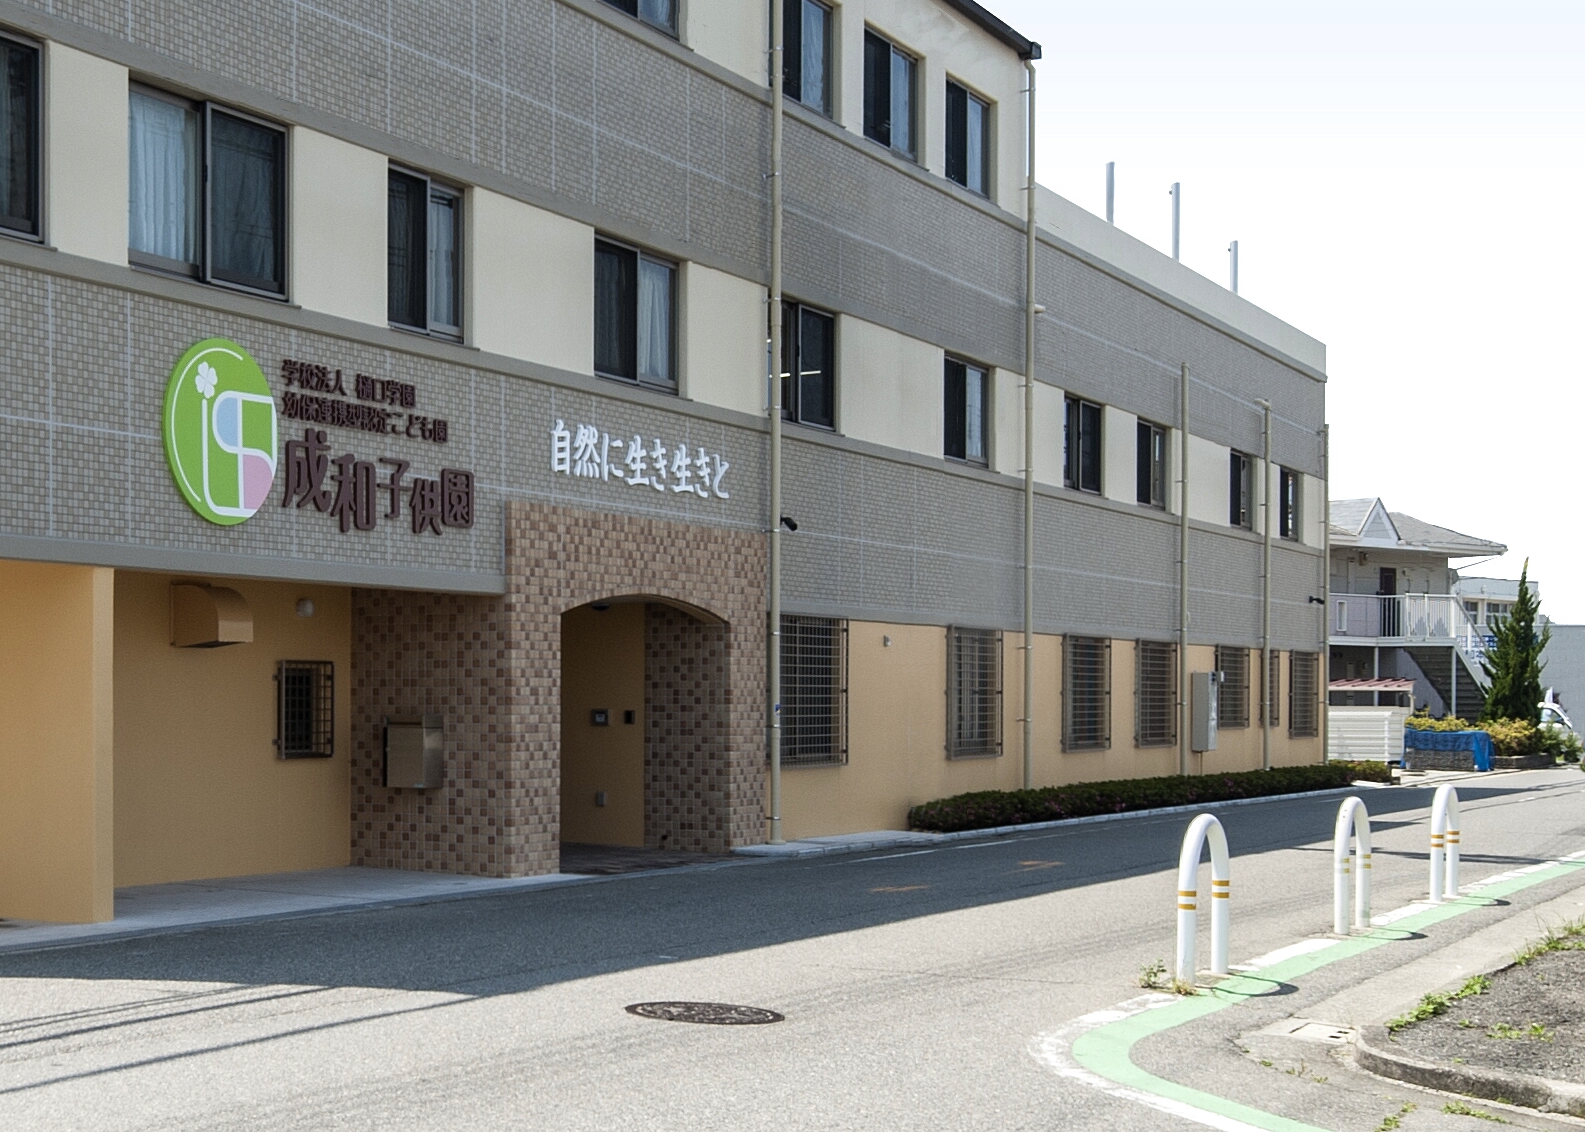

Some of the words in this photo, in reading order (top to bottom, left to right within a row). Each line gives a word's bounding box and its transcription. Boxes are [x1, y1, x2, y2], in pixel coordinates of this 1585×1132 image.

[281, 359, 347, 396] 学校法人
[282, 428, 475, 535] 成和子供園
[550, 419, 730, 499] 自然に生き生きと
